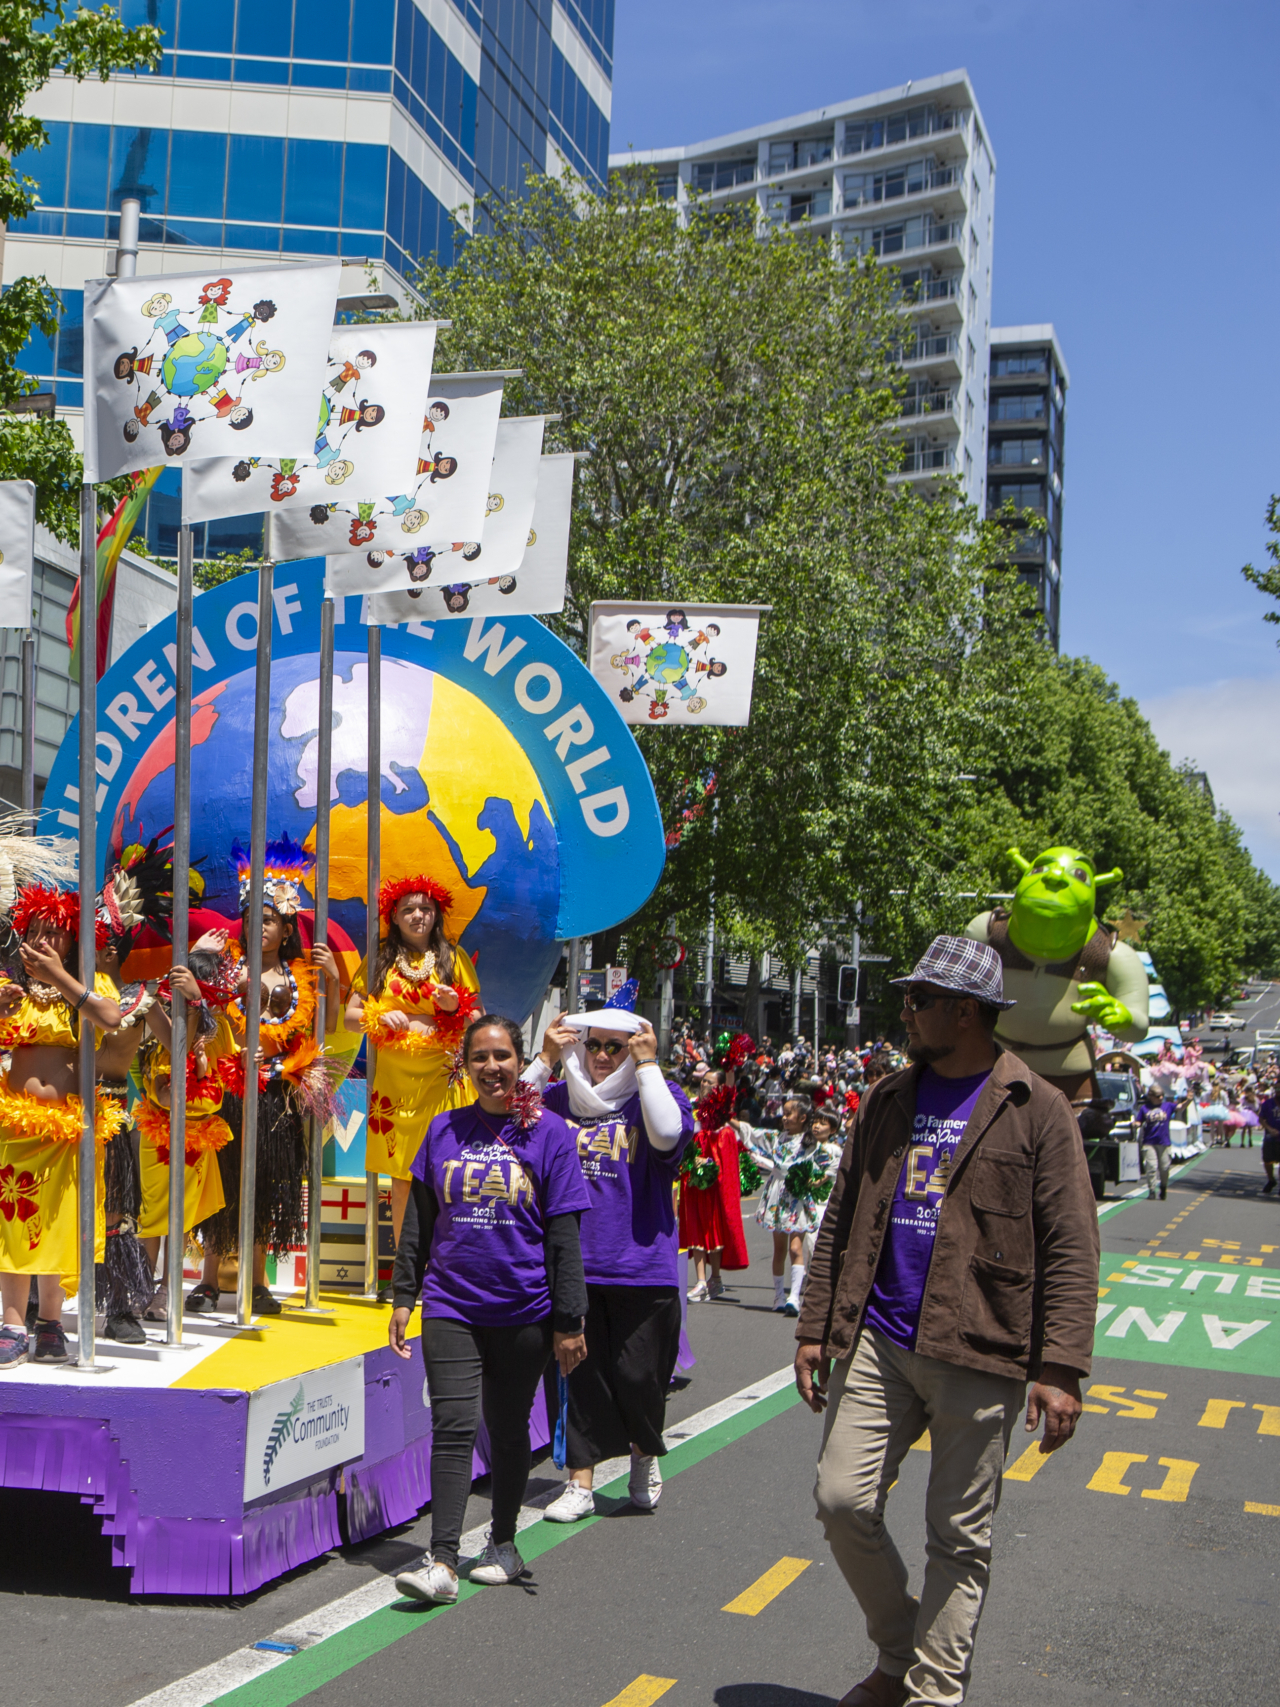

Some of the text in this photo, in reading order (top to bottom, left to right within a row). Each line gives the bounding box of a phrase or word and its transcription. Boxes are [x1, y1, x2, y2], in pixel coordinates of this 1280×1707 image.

[57, 583, 630, 838] ILDREN OF WORLD
[927, 1115, 968, 1129] Farmer
[911, 1128, 962, 1149] anta Par
[461, 1149, 519, 1164] Santa Para
[442, 1160, 534, 1208] TEAM
[891, 1217, 935, 1228] CELEBRATING
[307, 1394, 333, 1414] THE TRUSTS
[1082, 1384, 1280, 1436] US
[293, 1403, 350, 1444] Community
[315, 1433, 340, 1450] FOUNDATION
